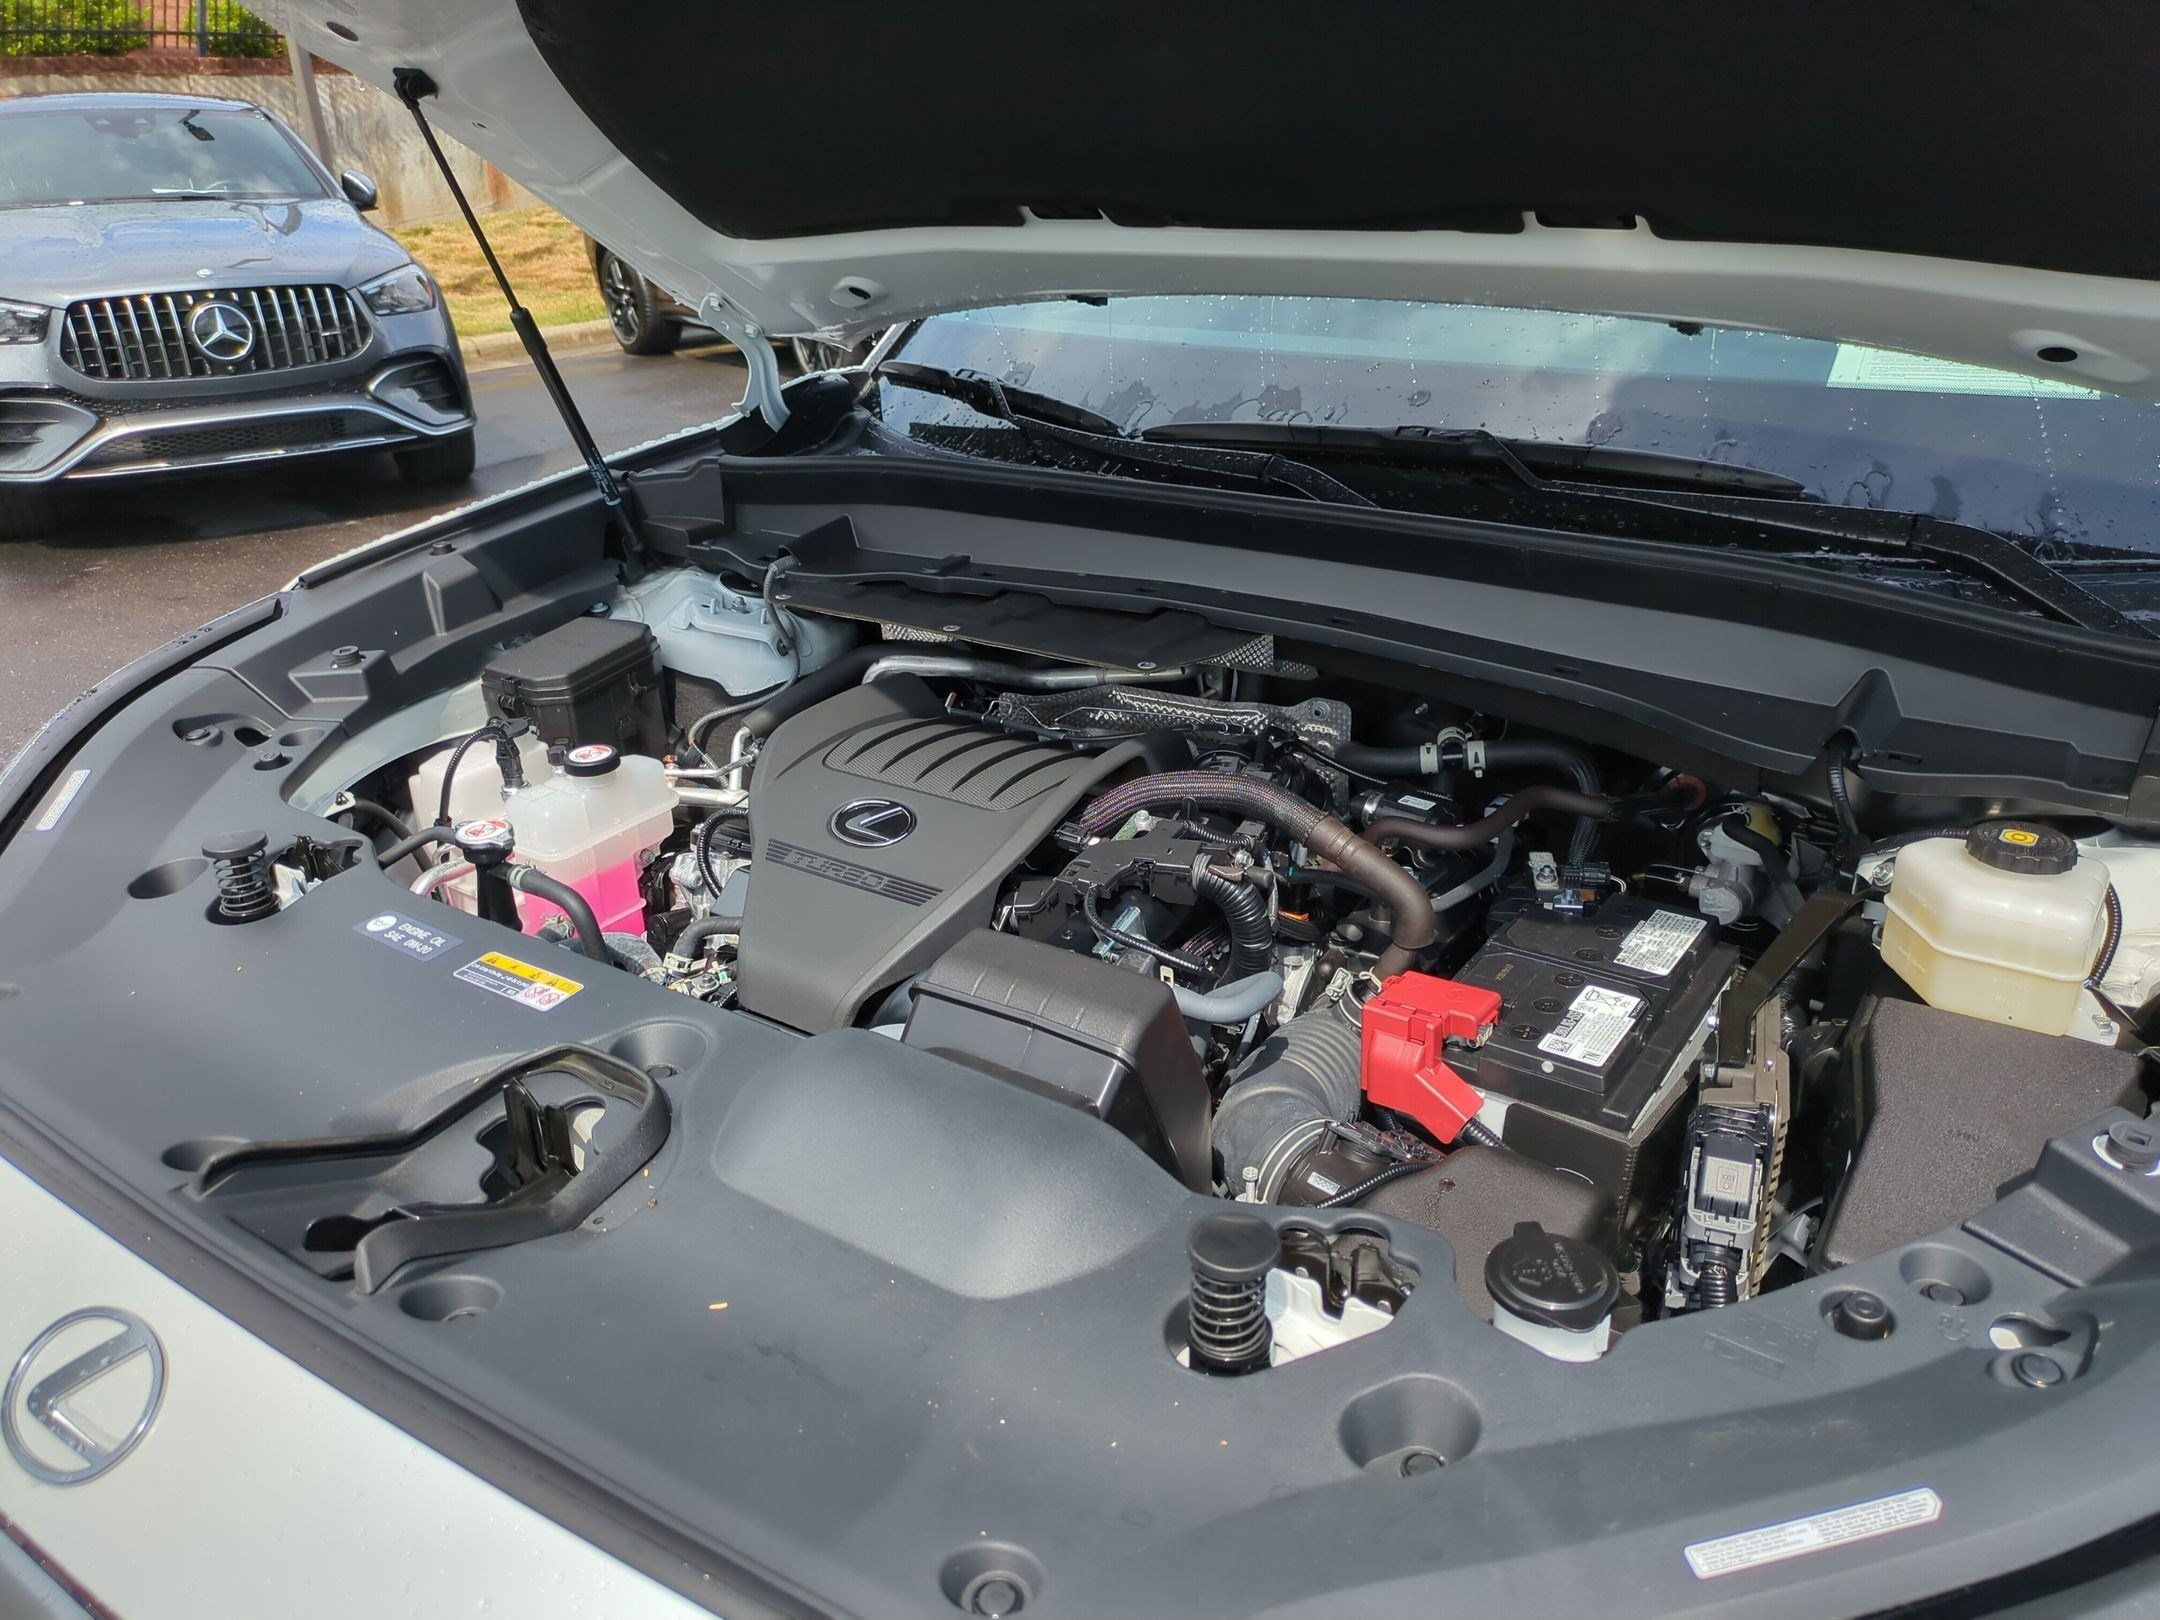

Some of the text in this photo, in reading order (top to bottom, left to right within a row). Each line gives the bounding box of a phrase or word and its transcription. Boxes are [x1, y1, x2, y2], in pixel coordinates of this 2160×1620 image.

[792, 851, 884, 888] TURBO
[383, 930, 406, 943] SAE
[398, 922, 447, 948] ENGINE OIL
